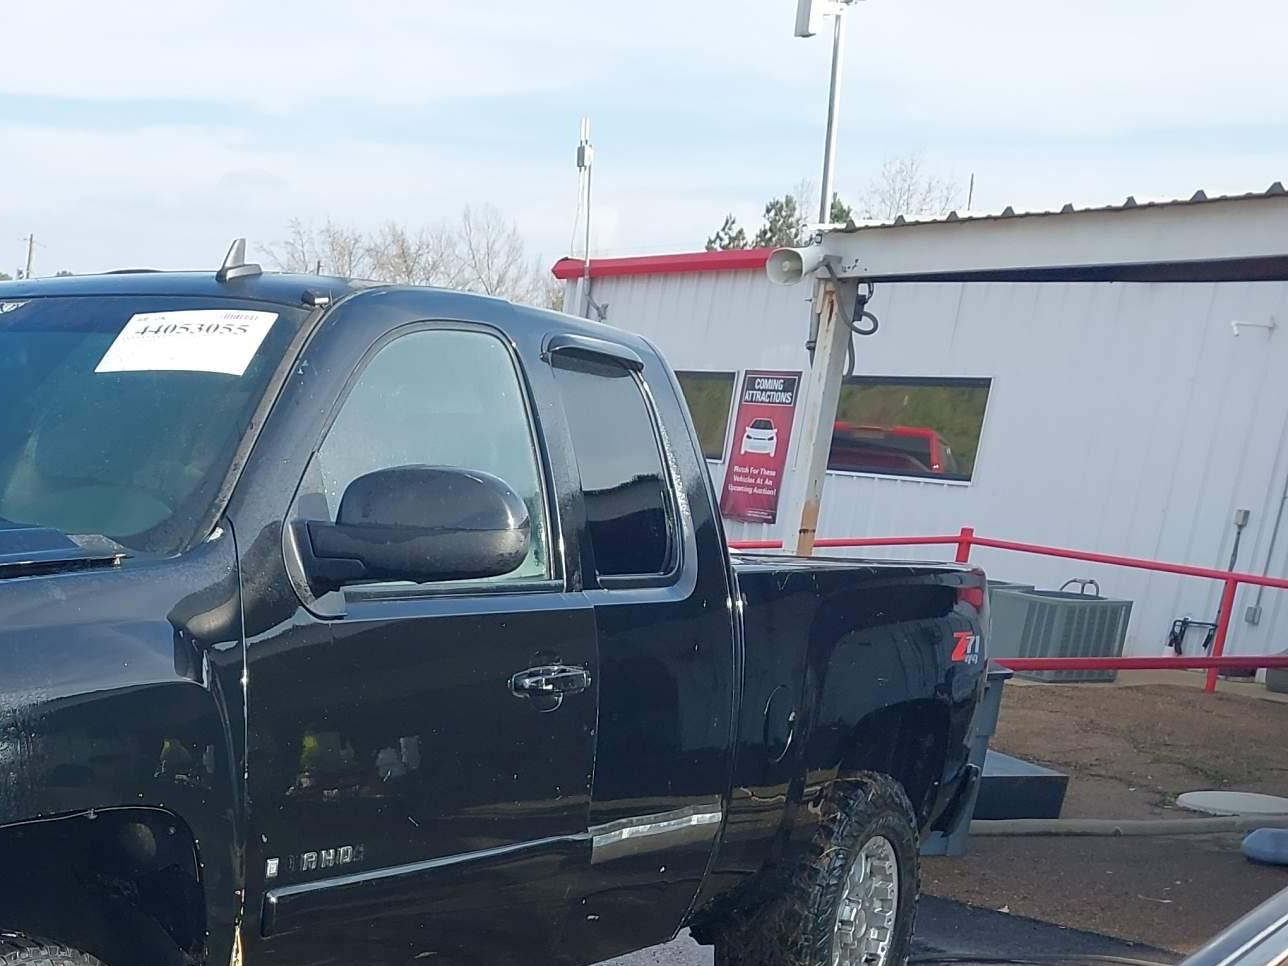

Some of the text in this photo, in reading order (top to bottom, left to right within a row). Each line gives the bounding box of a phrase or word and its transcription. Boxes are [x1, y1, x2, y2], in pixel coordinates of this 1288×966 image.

[135, 323, 249, 336] 44053055
[754, 378, 784, 390] COMING
[745, 390, 792, 404] ATTRACTIONS
[952, 631, 980, 661] Z71
